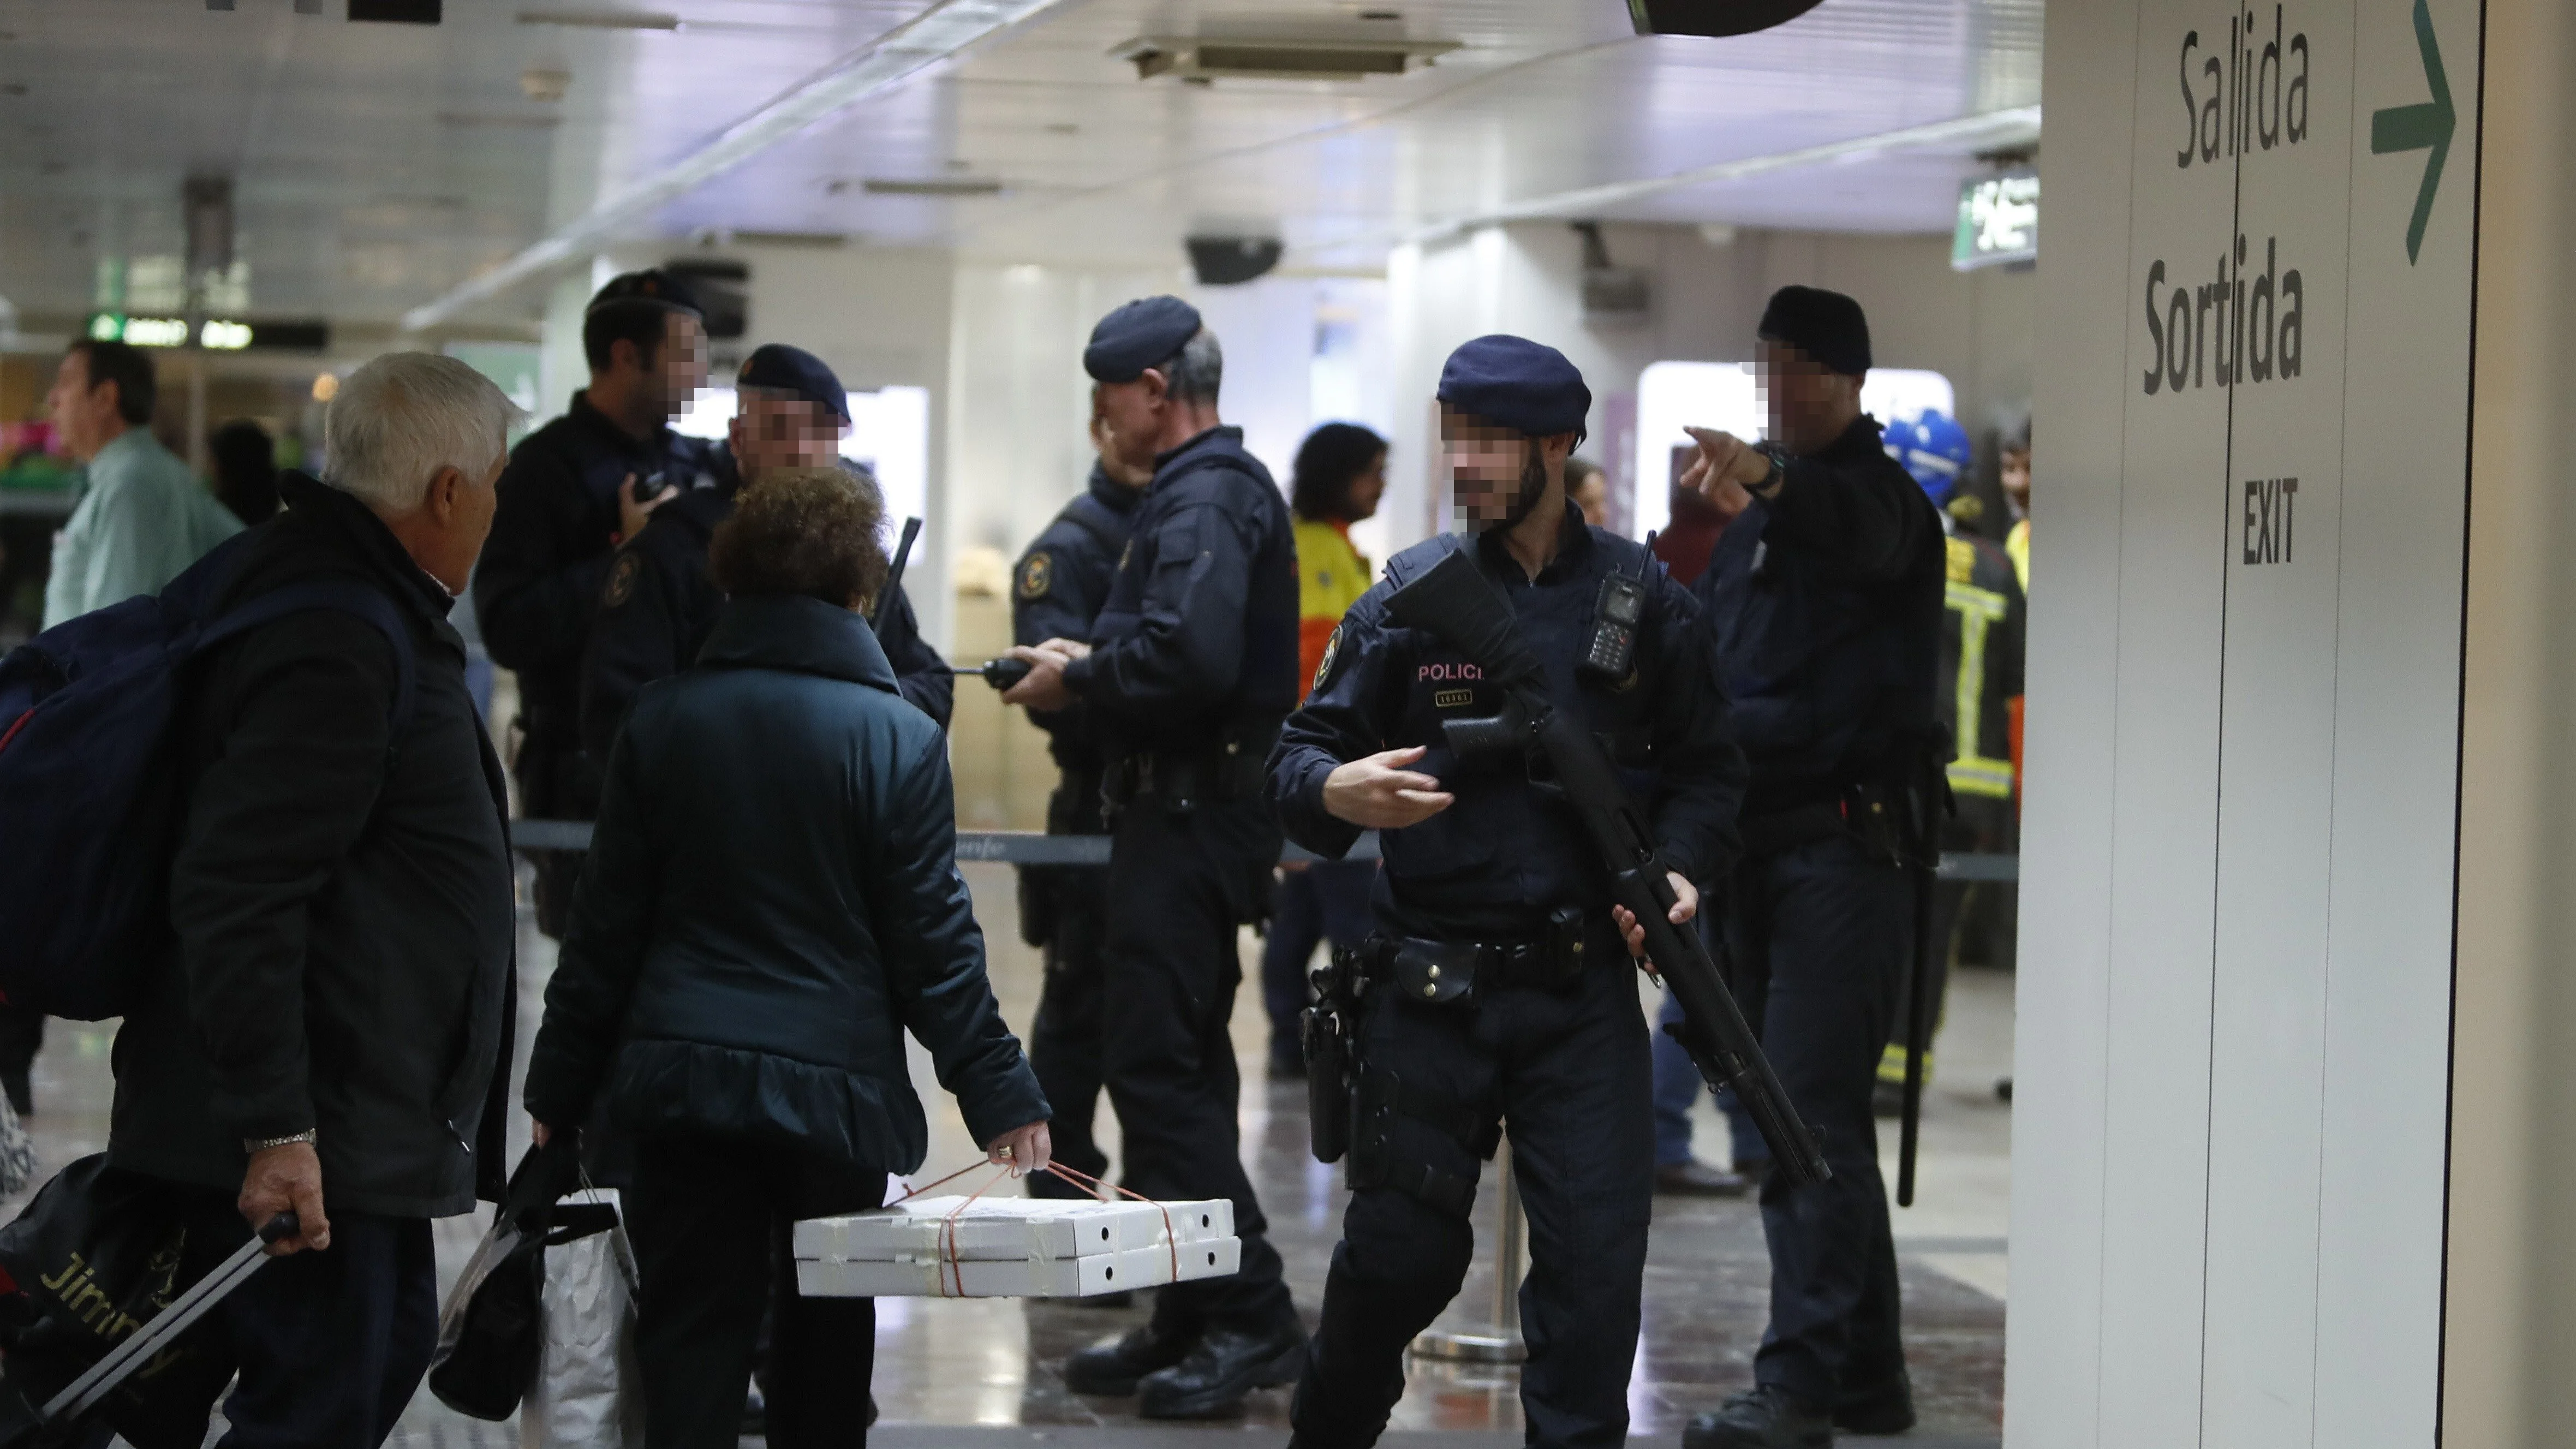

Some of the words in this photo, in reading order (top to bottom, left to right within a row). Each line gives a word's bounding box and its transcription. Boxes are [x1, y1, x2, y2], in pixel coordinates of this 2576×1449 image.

[2177, 3, 2310, 169] Salida
[2143, 234, 2303, 396] Sortida
[2243, 478, 2298, 565] EXIT
[1418, 663, 1483, 682] POLICI
[955, 837, 1005, 857] enfe
